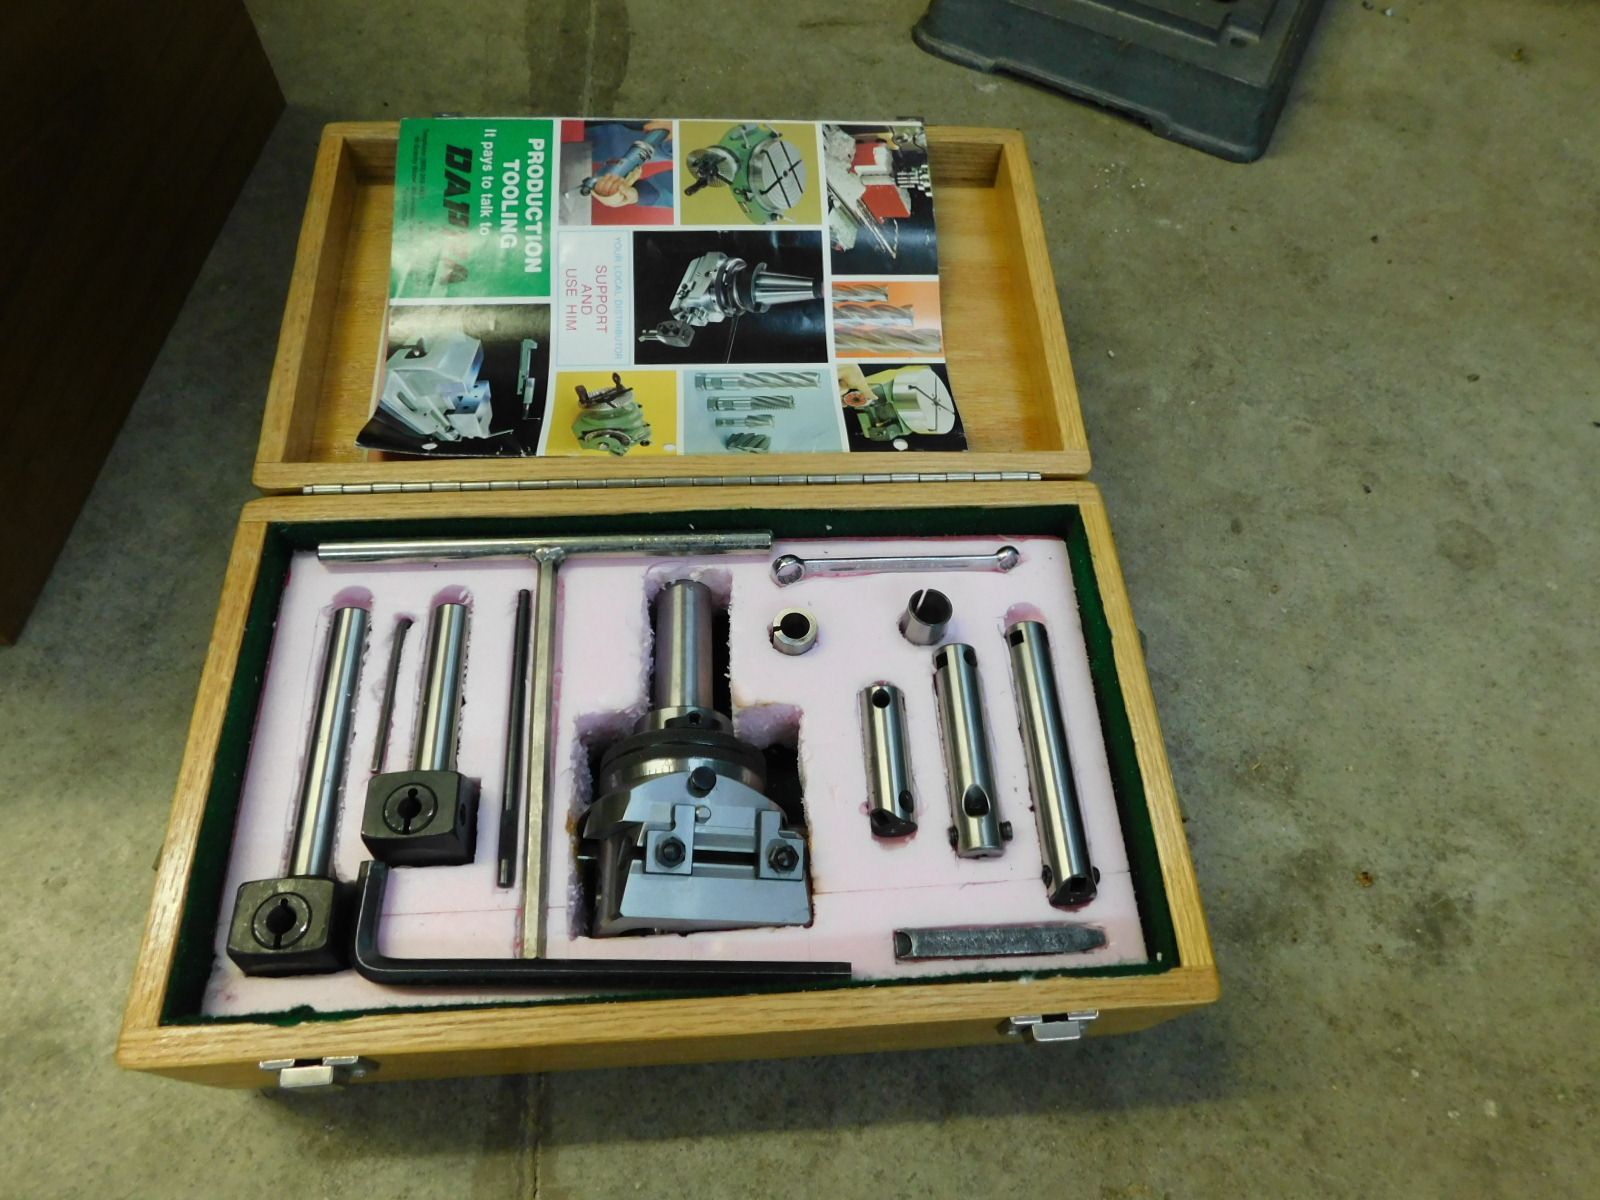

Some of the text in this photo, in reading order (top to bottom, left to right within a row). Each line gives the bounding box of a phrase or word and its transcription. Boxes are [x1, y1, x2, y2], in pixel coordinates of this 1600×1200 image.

[479, 128, 497, 236] It pays to talk to
[500, 159, 520, 249] TOOLING
[524, 138, 545, 273] PRODUCTION
[565, 268, 578, 331] USE HIM
[580, 284, 593, 315] AND
[595, 265, 608, 333] SUPPORT
[614, 237, 624, 359] YOUR LOCAL DISTRIBUTOR
